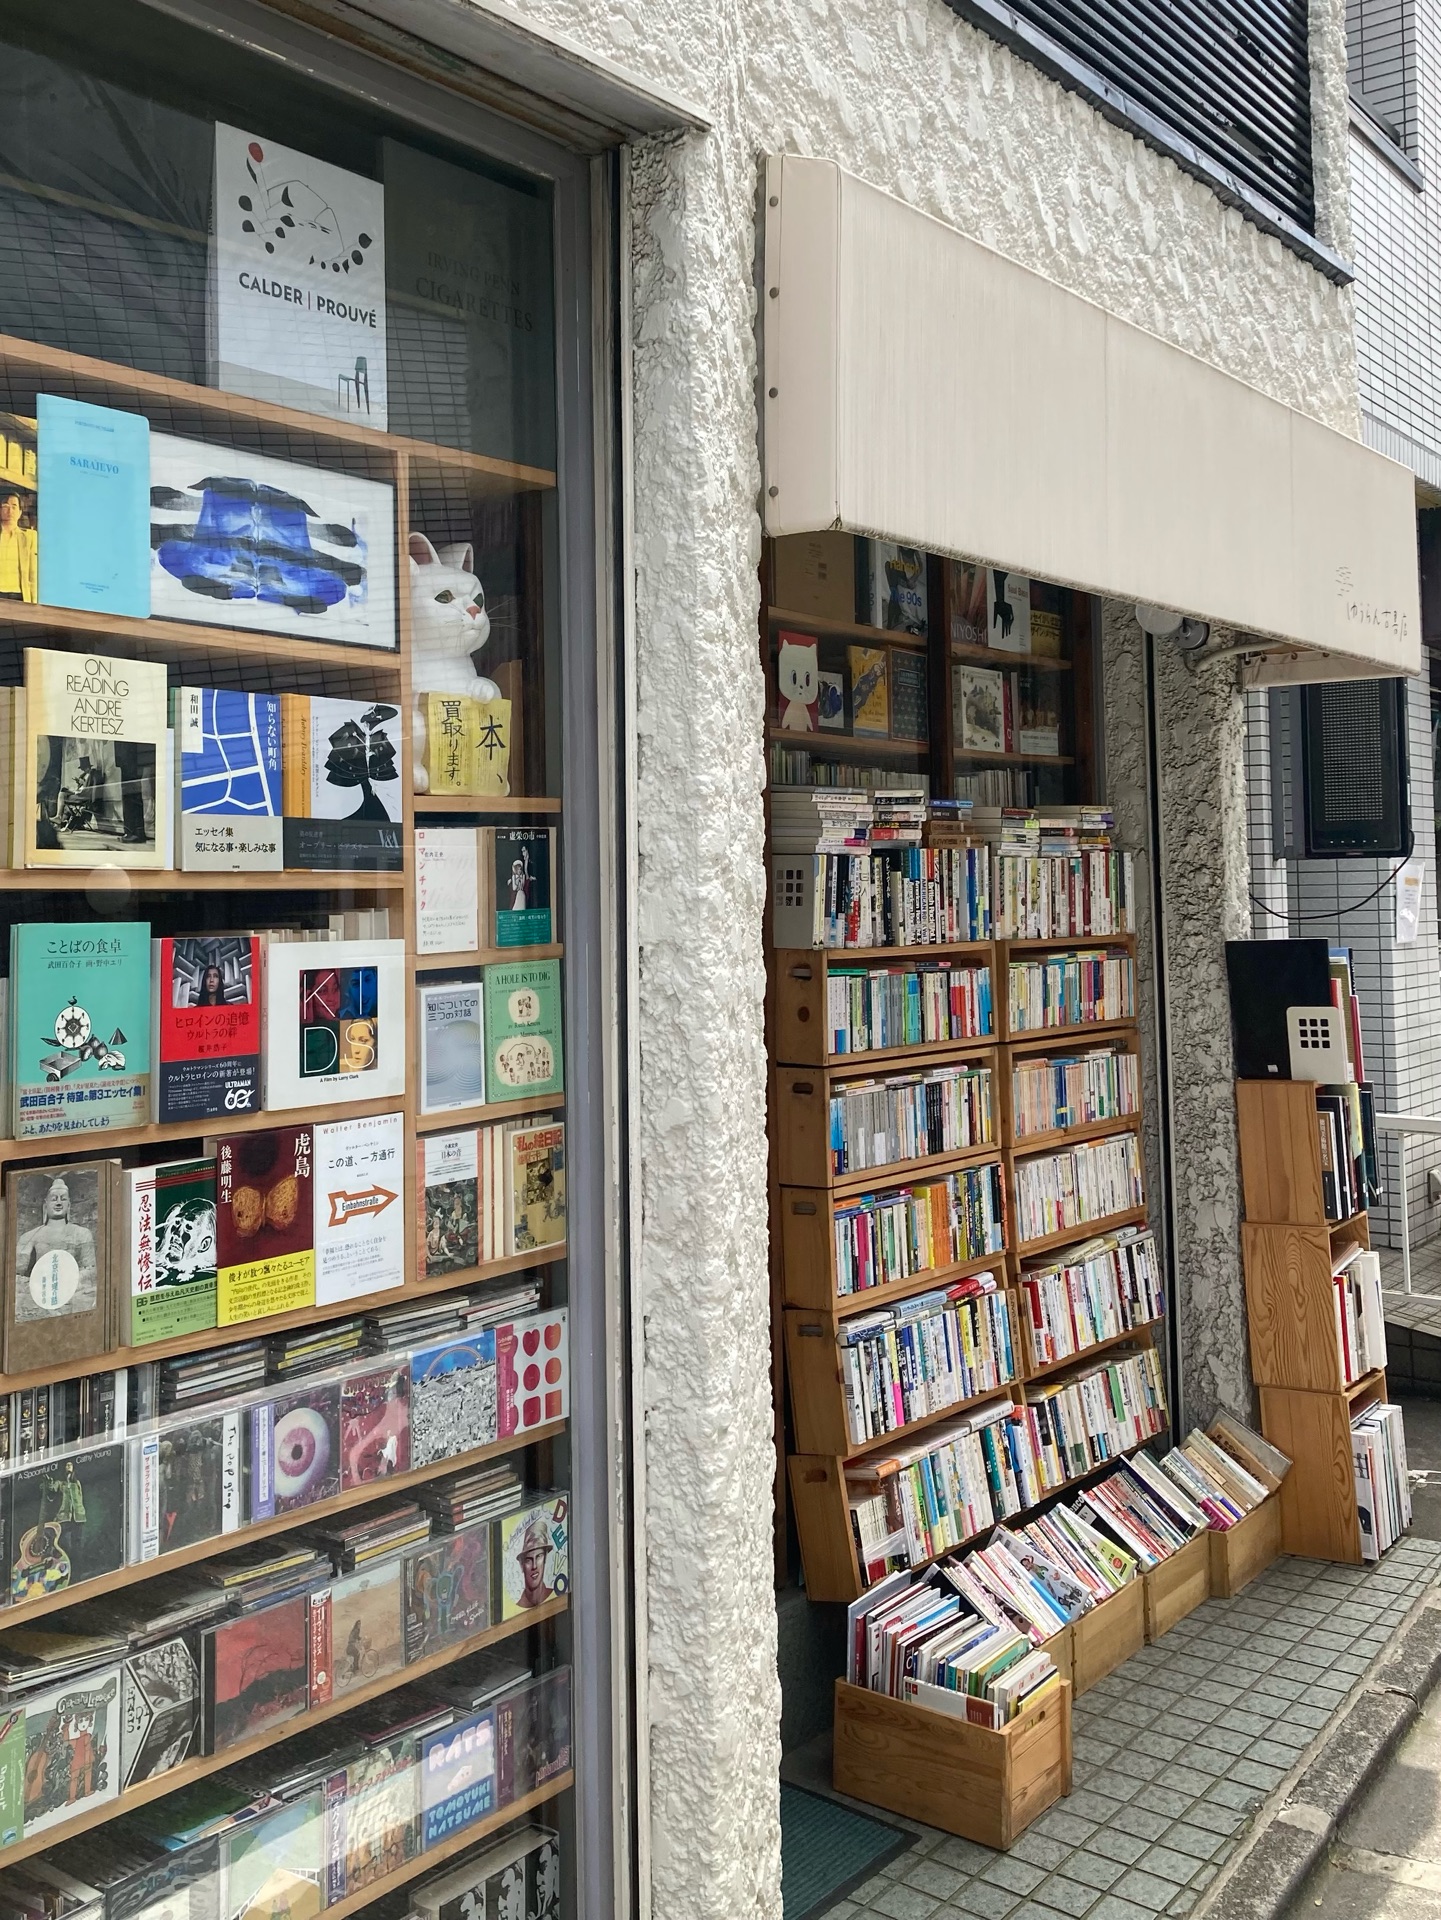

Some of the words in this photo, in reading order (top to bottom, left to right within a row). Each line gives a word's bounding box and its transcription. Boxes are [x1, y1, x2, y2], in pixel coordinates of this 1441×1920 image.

[428, 251, 480, 281] IRVING
[484, 270, 521, 297] PENN
[239, 272, 303, 305] CALDER
[317, 294, 377, 329] PROUVÉ
[415, 276, 534, 332] CIGARETTES
[69, 455, 120, 476] SARAJEVO
[906, 592, 922, 607] 90s
[84, 658, 112, 677] ON
[66, 674, 130, 697] READING
[73, 697, 123, 717] ANDRE
[70, 714, 124, 736] KERTESZ
[266, 700, 277, 771] 知らない町角
[441, 700, 466, 787] 買取ります。
[194, 827, 234, 838] エッセイ集
[194, 841, 277, 854] 気になる事・楽しみな事
[418, 831, 427, 911] ロマンチック
[46, 938, 123, 954] ことばの食卓
[47, 960, 82, 970] 武田百合子
[501, 974, 521, 985] HOLE
[539, 971, 551, 981] DIG
[427, 999, 478, 1012] 知についての
[427, 1009, 472, 1022] 三つの対話
[175, 1011, 250, 1029] ヒロインの追憶
[186, 1027, 238, 1042] ウルトラの絆
[224, 1079, 251, 1089] ULTRAMAN
[19, 1093, 65, 1108] 武田百合子
[357, 1117, 398, 1129] Benjamin
[516, 1129, 563, 1152] 私の絵日記
[328, 1148, 396, 1169] この道、一方通行
[220, 1145, 233, 1204] 後藤明生
[138, 1194, 153, 1292] 忍法無惨伝
[24, 1466, 50, 1480] Spoonful
[75, 1453, 93, 1464] Cathy
[93, 1449, 112, 1460] Young
[428, 1780, 490, 1823] TOMOYUKI
[428, 1796, 491, 1840] NATSUME
